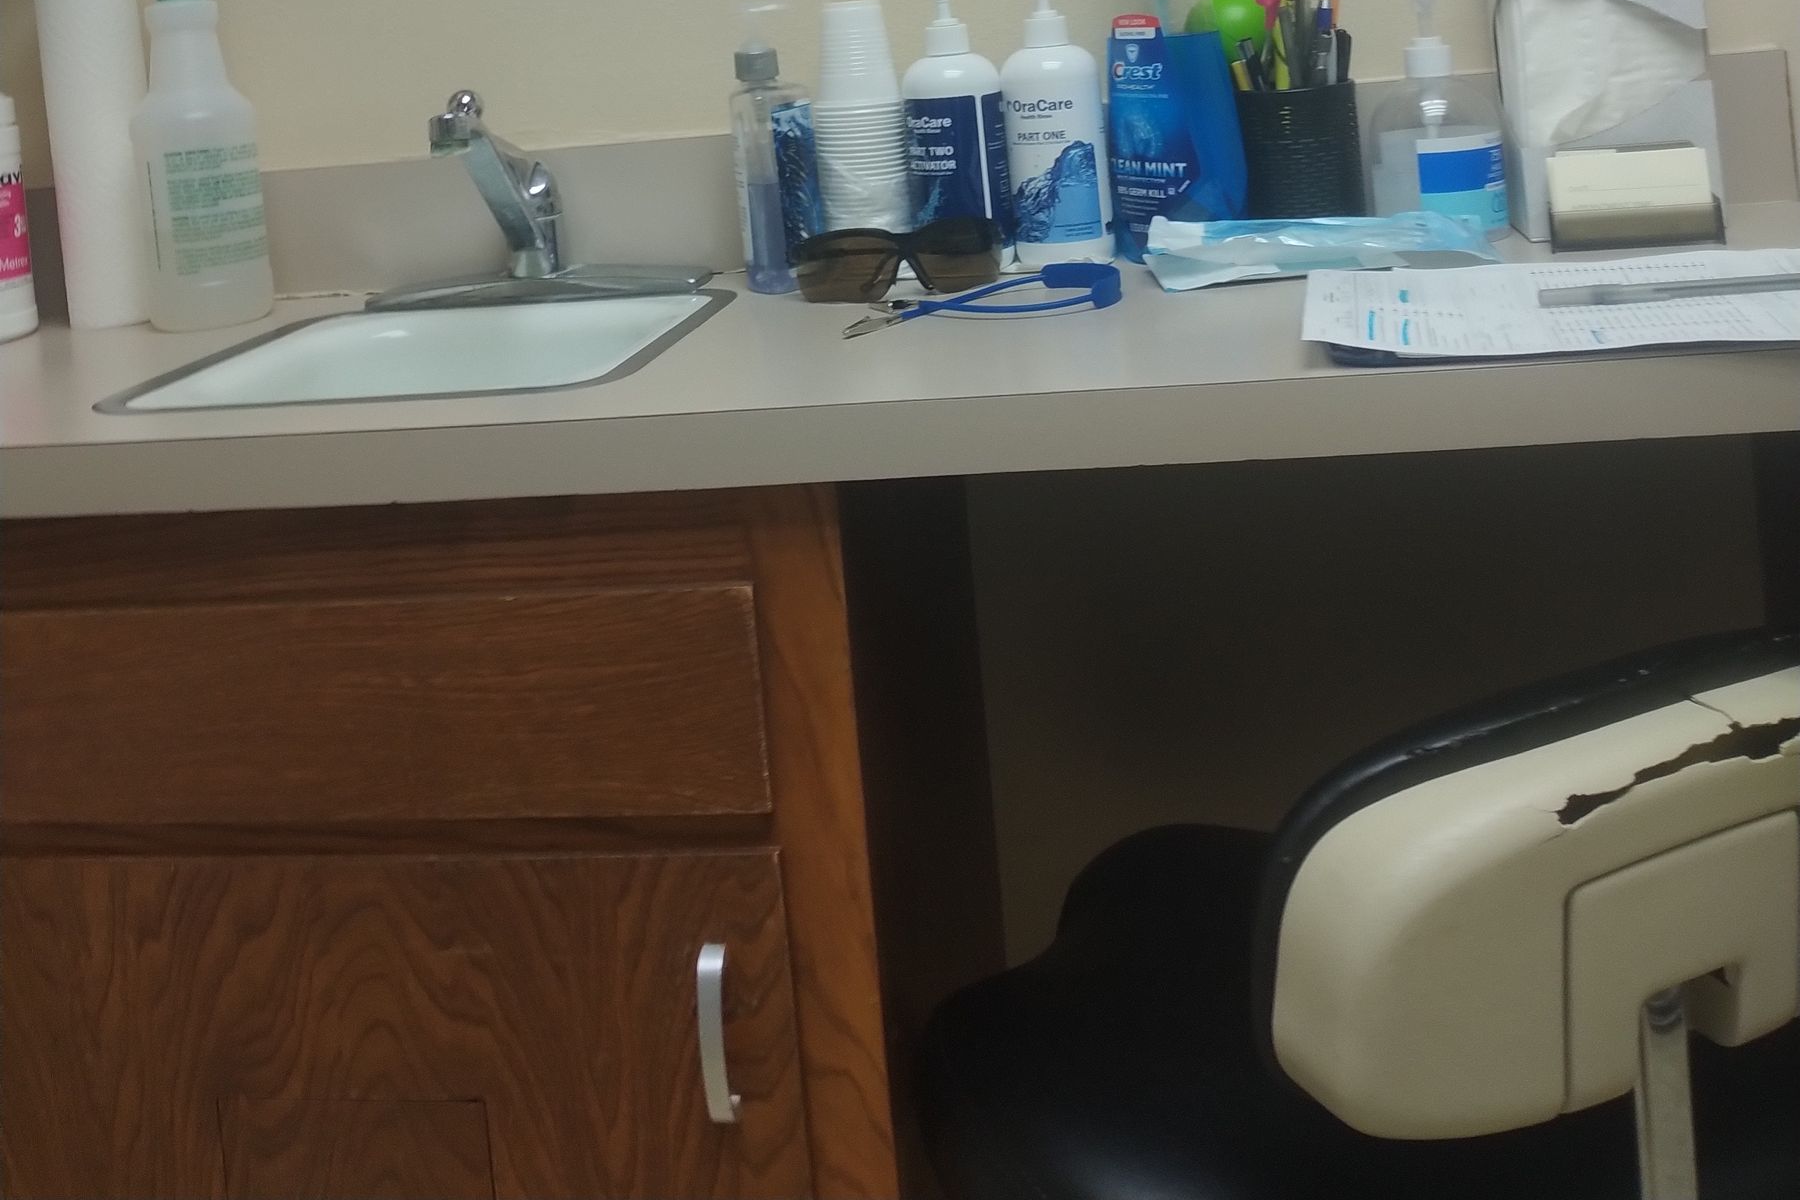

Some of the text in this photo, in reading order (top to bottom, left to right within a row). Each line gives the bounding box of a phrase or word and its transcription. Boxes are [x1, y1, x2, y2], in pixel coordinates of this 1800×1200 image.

[1113, 61, 1163, 80] Crest
[1013, 99, 1073, 113] OraCare
[1017, 130, 1067, 141] PART ONE
[928, 145, 954, 156] TWO
[1144, 161, 1187, 178] MINT
